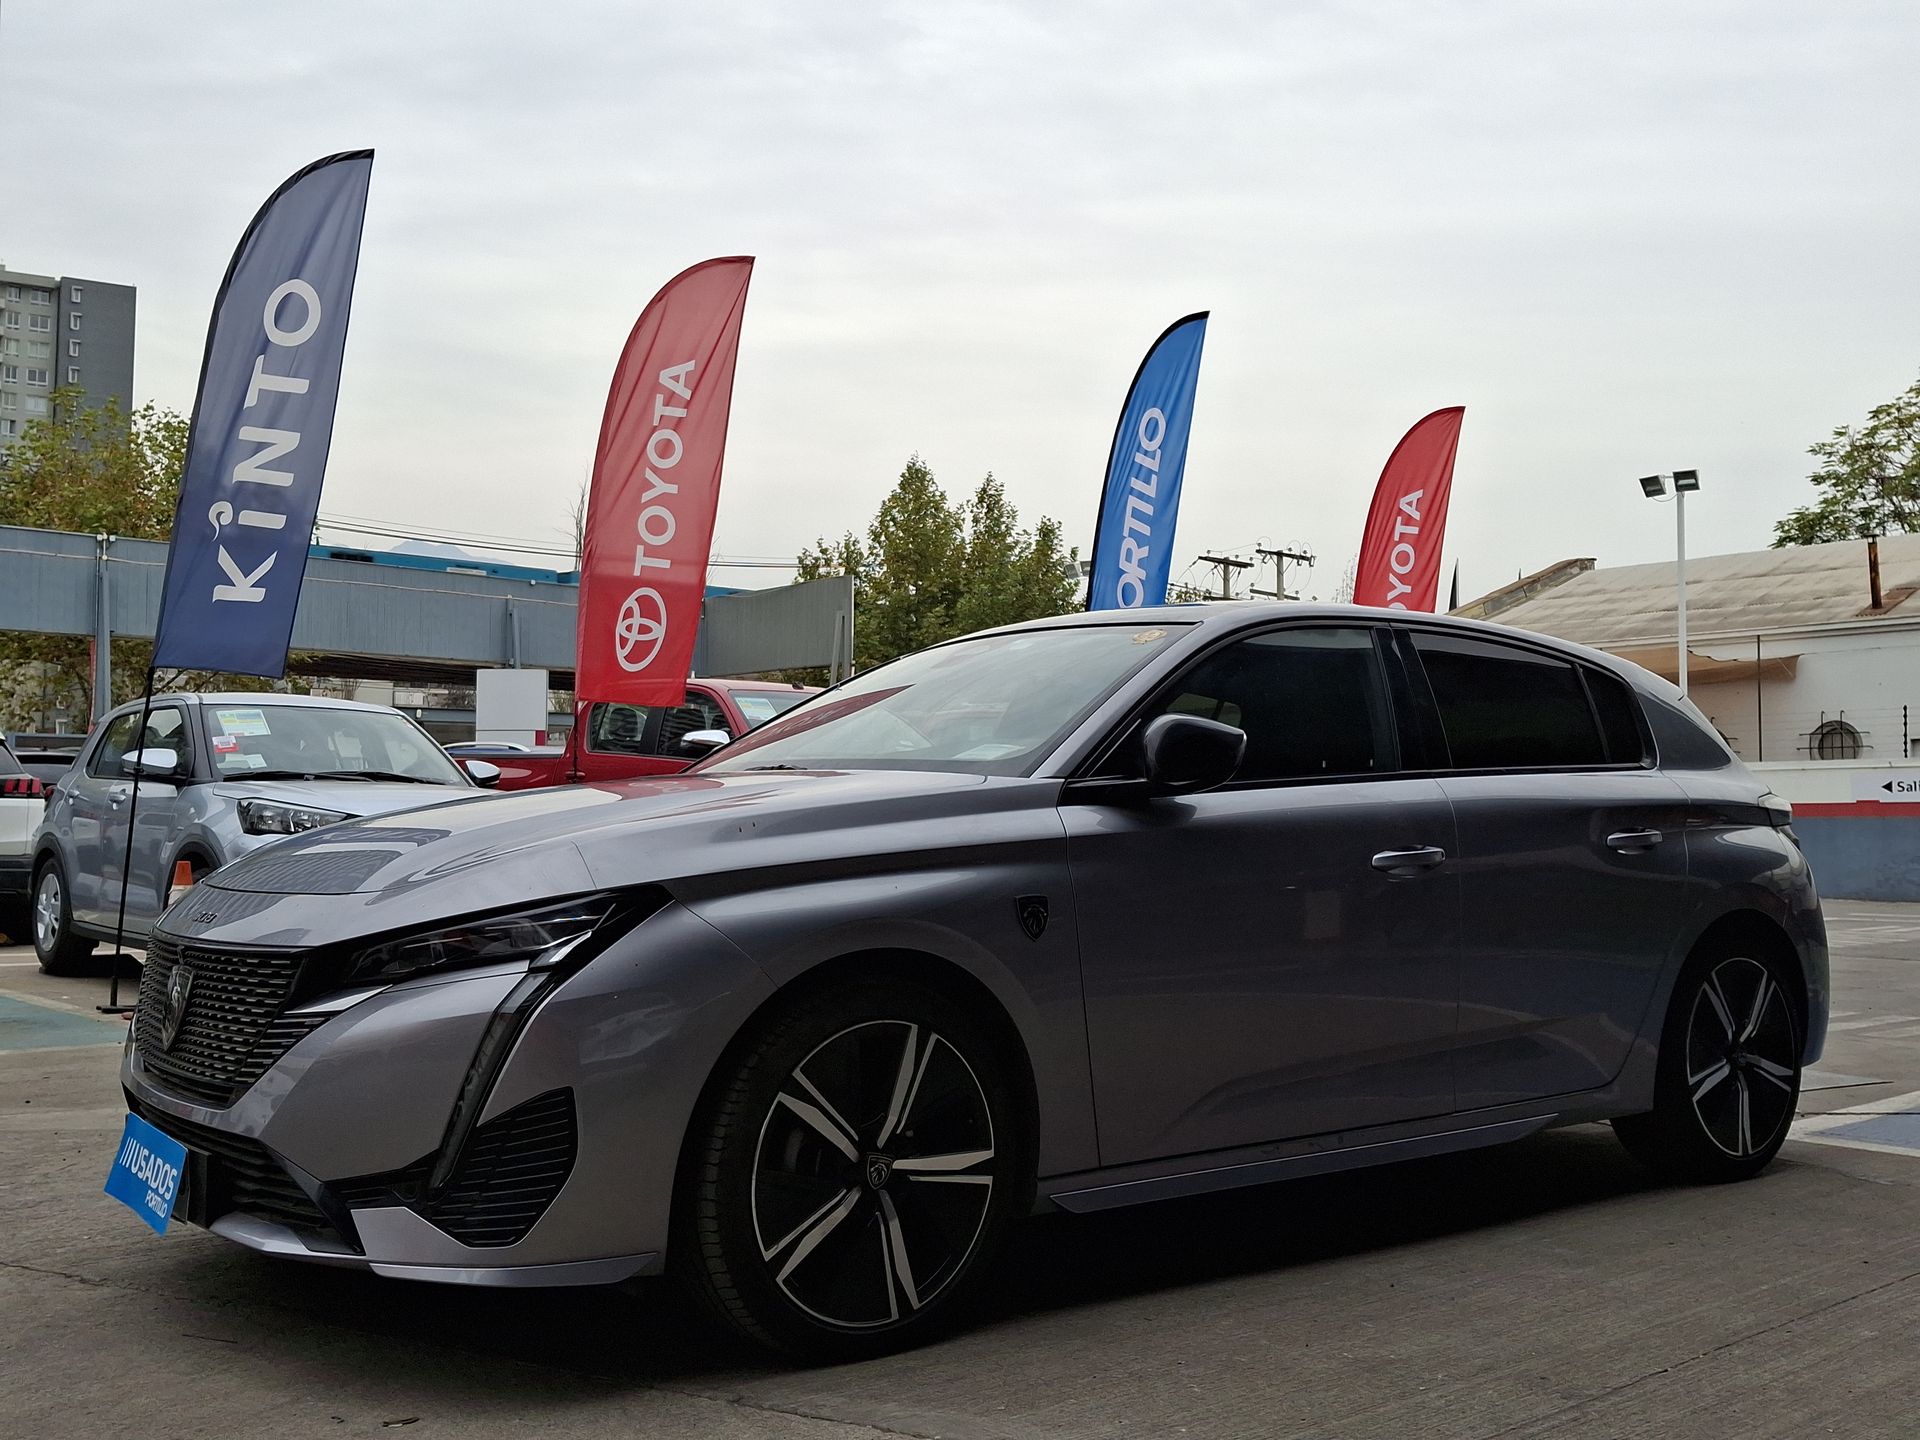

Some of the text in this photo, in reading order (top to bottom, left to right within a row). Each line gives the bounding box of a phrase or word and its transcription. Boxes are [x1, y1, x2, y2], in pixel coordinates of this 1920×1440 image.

[633, 359, 696, 577] TOYOTA
[1386, 488, 1424, 610] YOTA
[144, 1190, 168, 1219] PORTILLO
